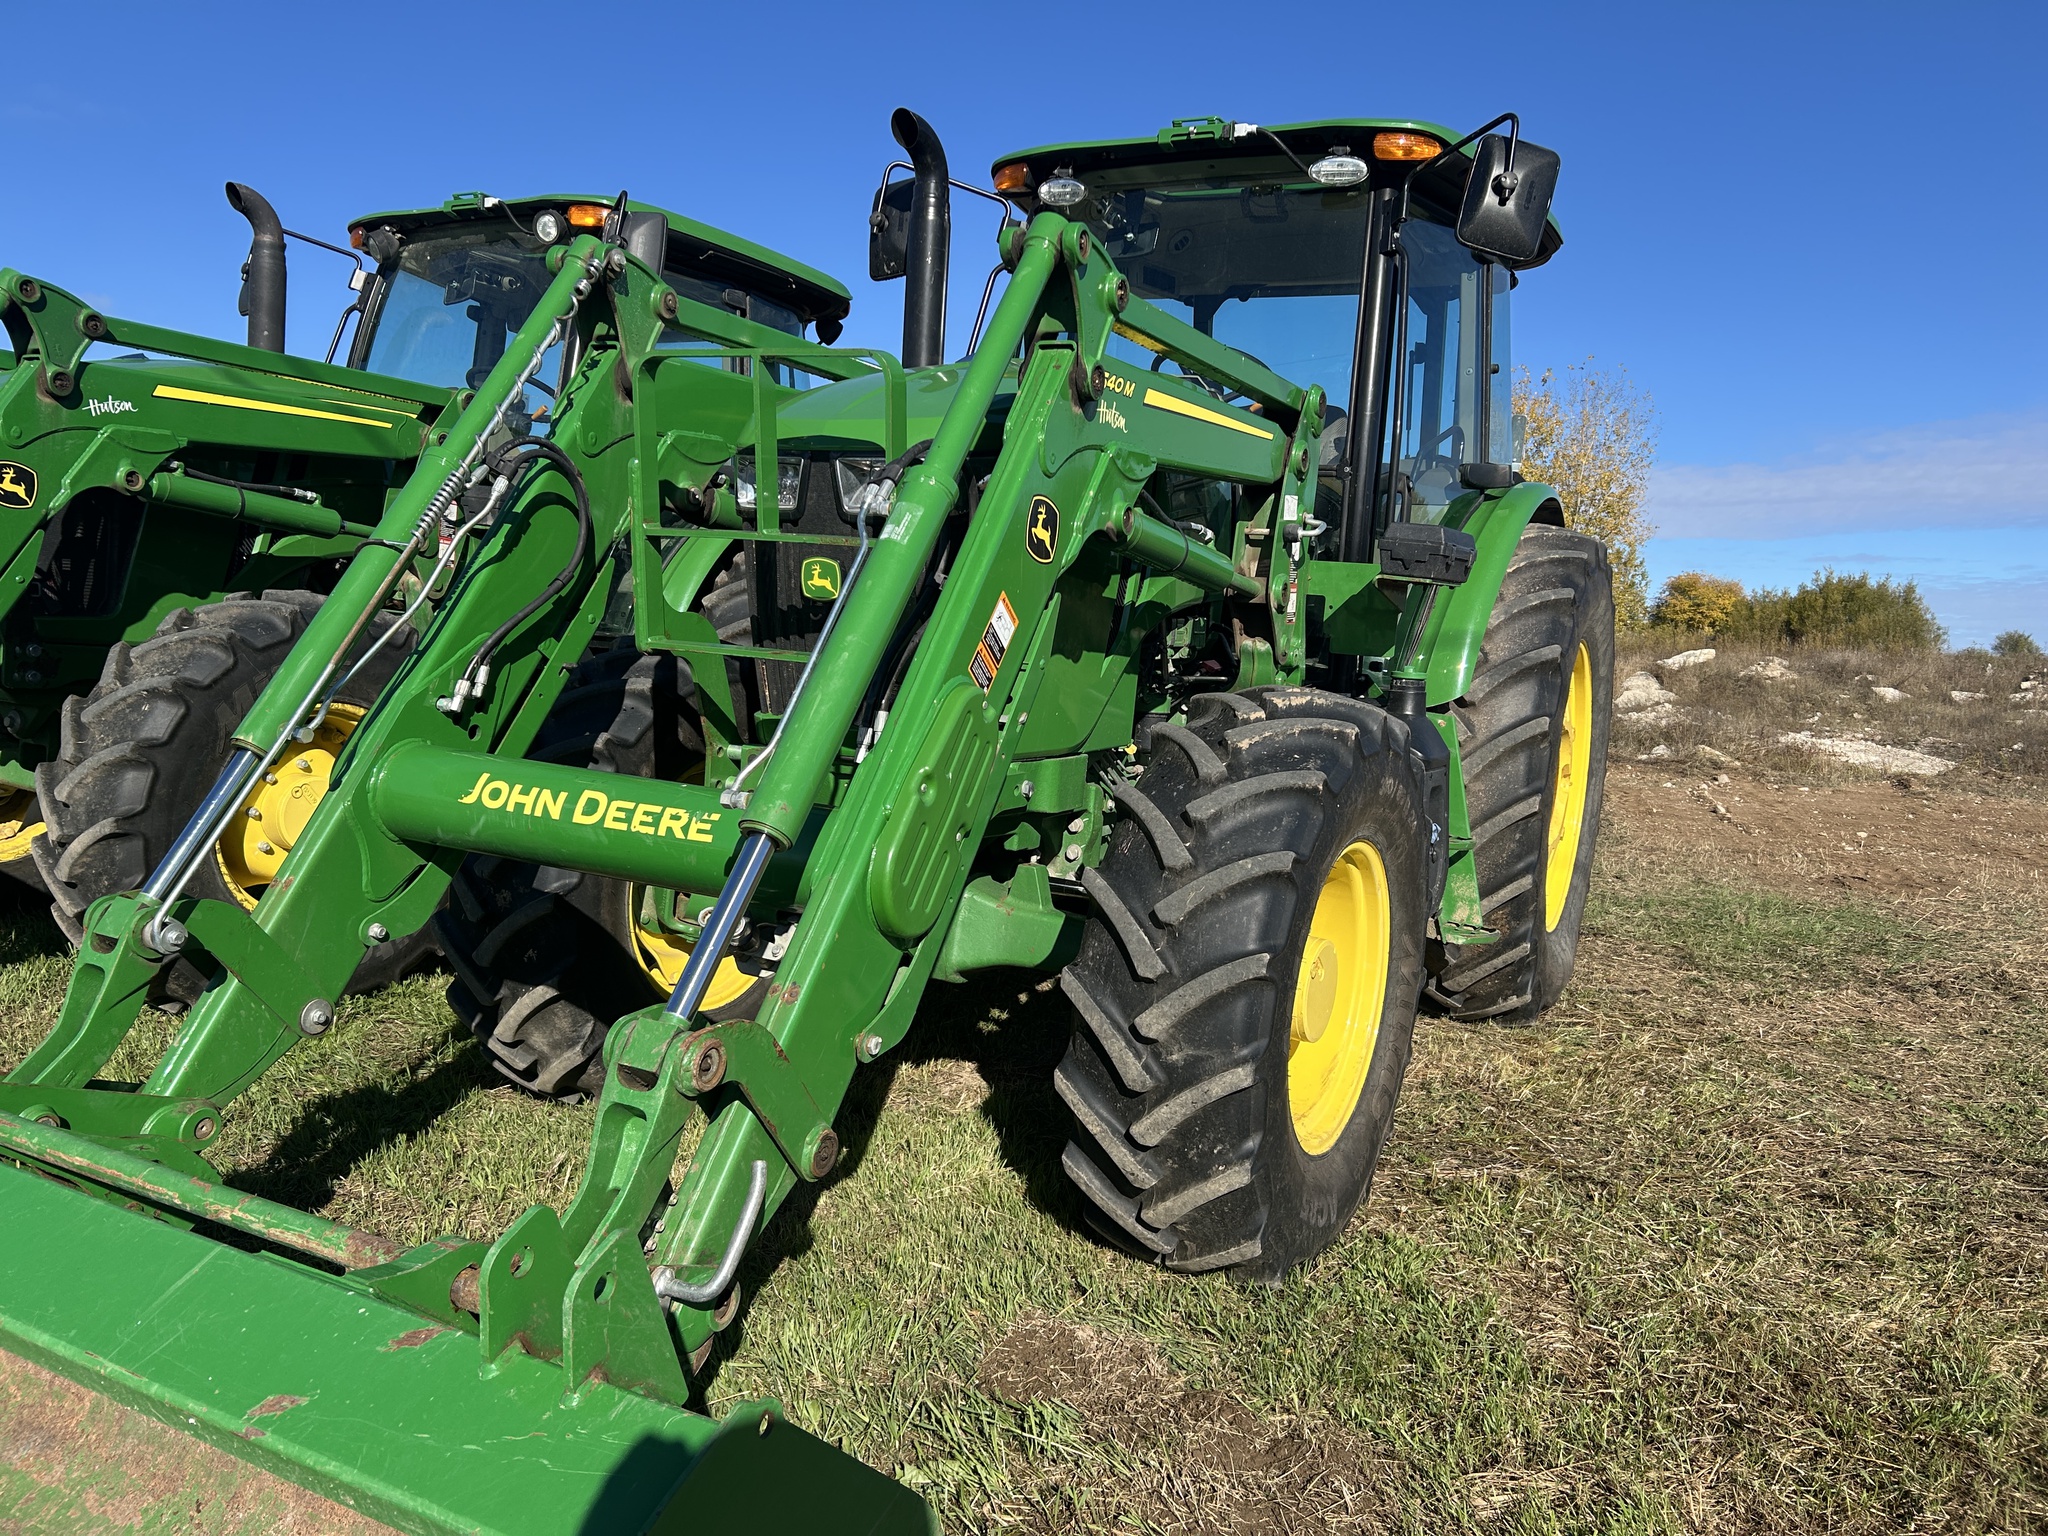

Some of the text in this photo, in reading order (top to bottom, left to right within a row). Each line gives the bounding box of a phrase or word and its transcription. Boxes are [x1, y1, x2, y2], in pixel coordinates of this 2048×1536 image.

[82, 395, 139, 417] Hutson
[1096, 399, 1128, 433] Hutson
[457, 772, 722, 843] JOHN DEERE
